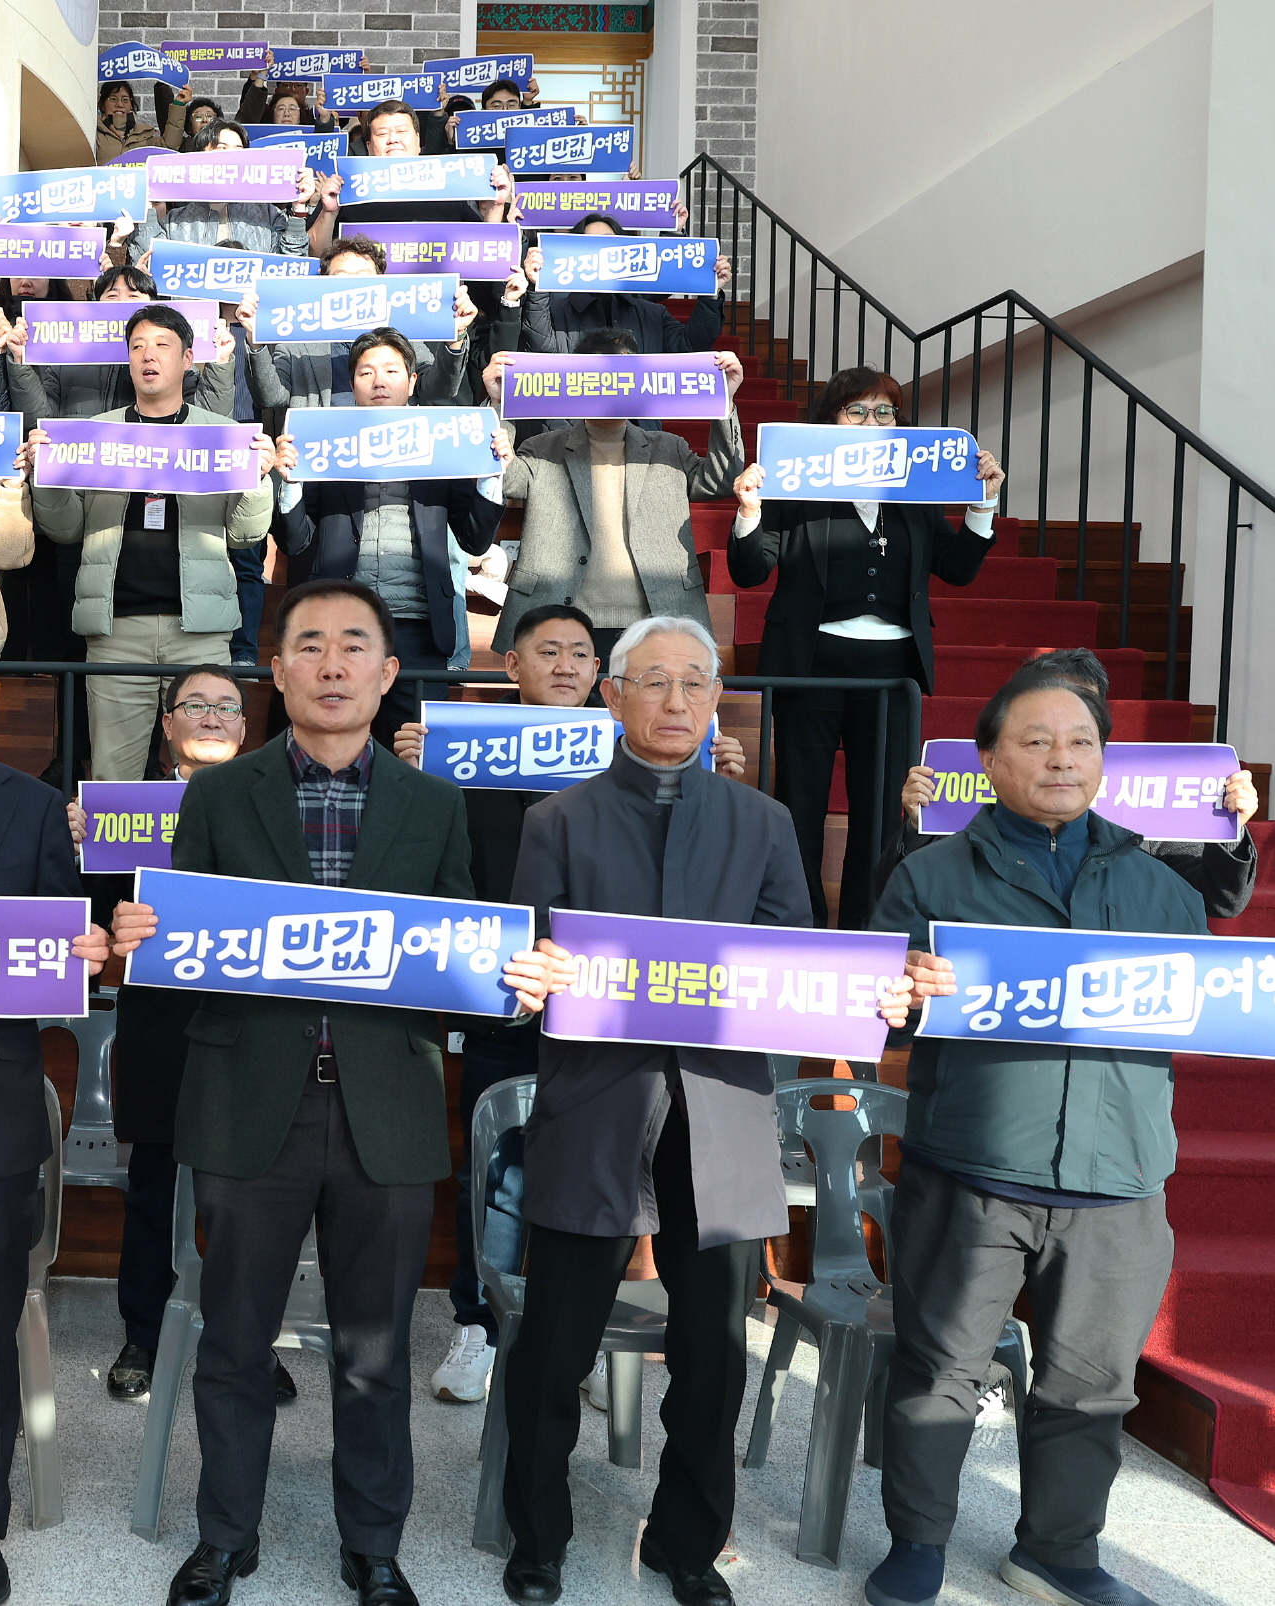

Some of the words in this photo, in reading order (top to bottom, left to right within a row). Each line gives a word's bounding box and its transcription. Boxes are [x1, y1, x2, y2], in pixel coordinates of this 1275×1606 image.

[100, 56, 128, 78] 강진
[133, 51, 158, 70] 반값
[162, 54, 183, 73] 여행
[189, 48, 224, 60] 방문인구
[226, 48, 244, 59] 시대
[245, 47, 264, 60] 도약
[270, 61, 295, 78] 강진
[299, 56, 327, 73] 반값
[331, 52, 356, 70] 여행
[464, 62, 494, 83] 반값
[498, 57, 527, 78] 여행
[332, 84, 362, 106] 강진
[366, 81, 398, 100] 반값
[404, 76, 433, 98] 여행
[466, 124, 496, 143] 강진
[510, 143, 545, 169] 강진
[550, 137, 587, 158] 반값
[595, 130, 630, 154] 여행
[152, 166, 186, 183] 700만
[189, 165, 238, 183] 방문인구
[242, 166, 267, 184] 시대
[270, 165, 297, 183] 도약
[350, 169, 388, 196] 강진
[396, 162, 435, 183] 반값
[445, 156, 485, 178] 여행
[1, 191, 41, 218] 강진
[47, 183, 88, 205] 반값
[95, 173, 136, 199] 여행
[521, 192, 556, 211] 700만
[560, 193, 611, 210] 방문인구
[614, 193, 640, 210] 시대
[644, 193, 671, 212] 도약
[38, 240, 65, 259] 시대
[69, 241, 97, 260] 도약
[390, 242, 446, 262] 방문인구
[450, 242, 479, 262] 시대
[482, 240, 512, 262] 도약
[554, 259, 598, 286] 강진
[606, 247, 651, 272] 반값
[660, 242, 705, 269] 여행
[161, 263, 205, 289] 강진
[213, 261, 255, 283] 반값
[271, 305, 321, 336] 강진
[329, 293, 378, 318] 반값
[391, 281, 443, 313] 여행
[32, 322, 74, 343] 700만
[79, 320, 127, 343] 방문인
[513, 372, 560, 397] 700만
[565, 372, 636, 396] 방문인구
[640, 372, 676, 395] 시대
[681, 372, 716, 395] 도약
[304, 437, 360, 472] 강진
[369, 425, 419, 451] 반값
[433, 410, 484, 447] 여행
[47, 443, 96, 464] 700만
[100, 444, 169, 469] 방문인구
[174, 447, 209, 472] 시대
[213, 449, 250, 471] 도약
[774, 454, 833, 491] 강진
[843, 443, 898, 480] 반값
[911, 436, 968, 473] 여행
[446, 738, 519, 780] 강진
[532, 725, 603, 765] 반값
[1115, 775, 1167, 809] 시대
[1172, 776, 1225, 809] 도약
[92, 813, 155, 843] 700만
[7, 937, 69, 979] 도약
[164, 928, 261, 980] 강진
[281, 917, 377, 970] 반값
[402, 915, 502, 974] 여행
[572, 954, 640, 1000] 00만
[647, 960, 769, 1012] 방문인구
[777, 968, 838, 1016] 시대
[961, 977, 1062, 1031] 강진
[1082, 961, 1177, 1019] 반값
